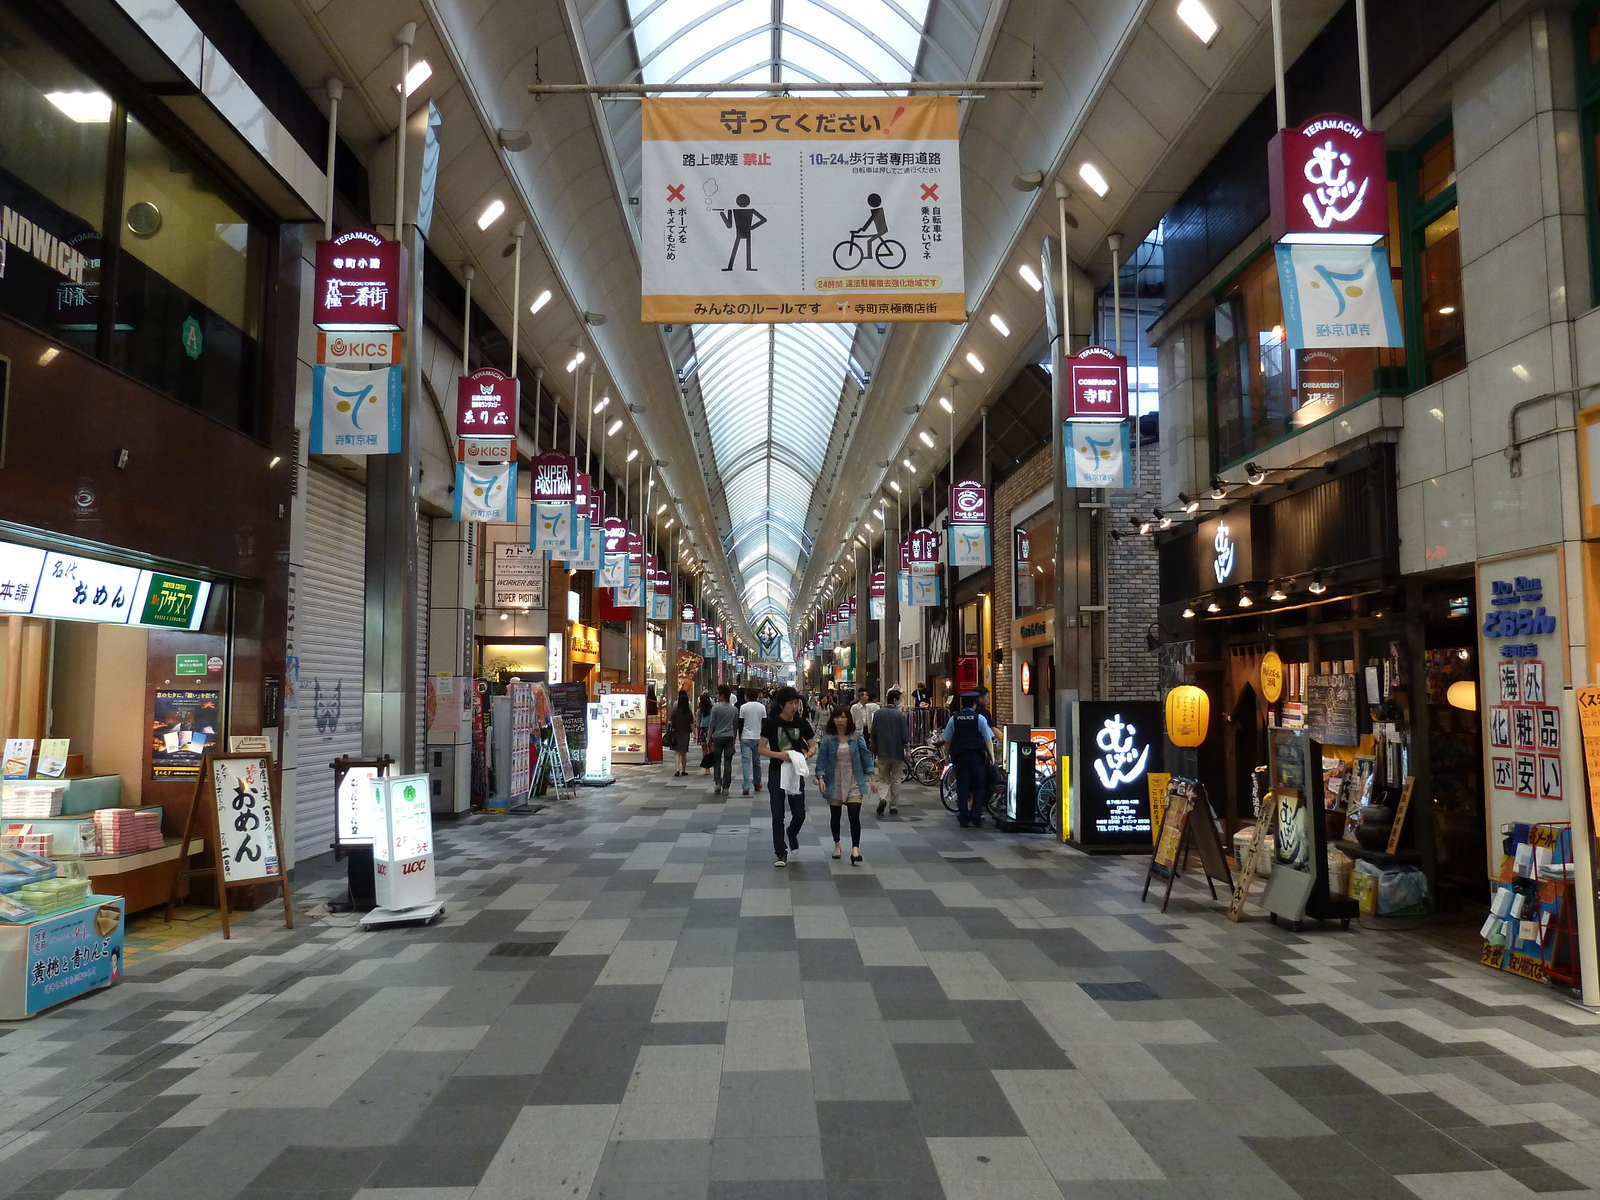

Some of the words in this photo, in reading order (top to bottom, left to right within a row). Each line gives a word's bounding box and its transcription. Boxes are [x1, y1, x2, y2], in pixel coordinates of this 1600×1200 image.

[1302, 120, 1362, 139] TERAMACHI
[682, 153, 739, 167] 路上喫煙
[743, 153, 772, 166] 禁止
[678, 207, 687, 244] ポーズを
[933, 206, 942, 242] 自転車は
[333, 231, 382, 247] TERAMACHI
[666, 208, 676, 261] キメてもだめ
[921, 206, 932, 260] 乗らないでネ
[0, 205, 84, 285] NDWICH
[693, 302, 822, 316] みんなのルールです
[854, 303, 938, 315] 寺町京極商店街
[349, 342, 388, 357] KICS
[1078, 347, 1115, 360] TERAMACHI
[471, 370, 504, 382] TERAMACHI
[1082, 388, 1113, 404] 寺町
[335, 434, 378, 446] 寺町京極
[480, 446, 508, 457] KICS
[537, 464, 569, 480] SUPER
[534, 478, 572, 495] POSITION
[496, 579, 526, 587] WORKER
[72, 580, 126, 609] おめん
[497, 593, 516, 603] SUPER
[518, 593, 541, 603] POSITION
[1502, 665, 1540, 701] 海外
[1493, 709, 1558, 748] 化粧品
[1496, 757, 1559, 795] が安い
[232, 786, 262, 863] おめん
[377, 863, 387, 876] UCC
[402, 859, 426, 875] UCC
[32, 937, 111, 985] 黄桃と青りんご
